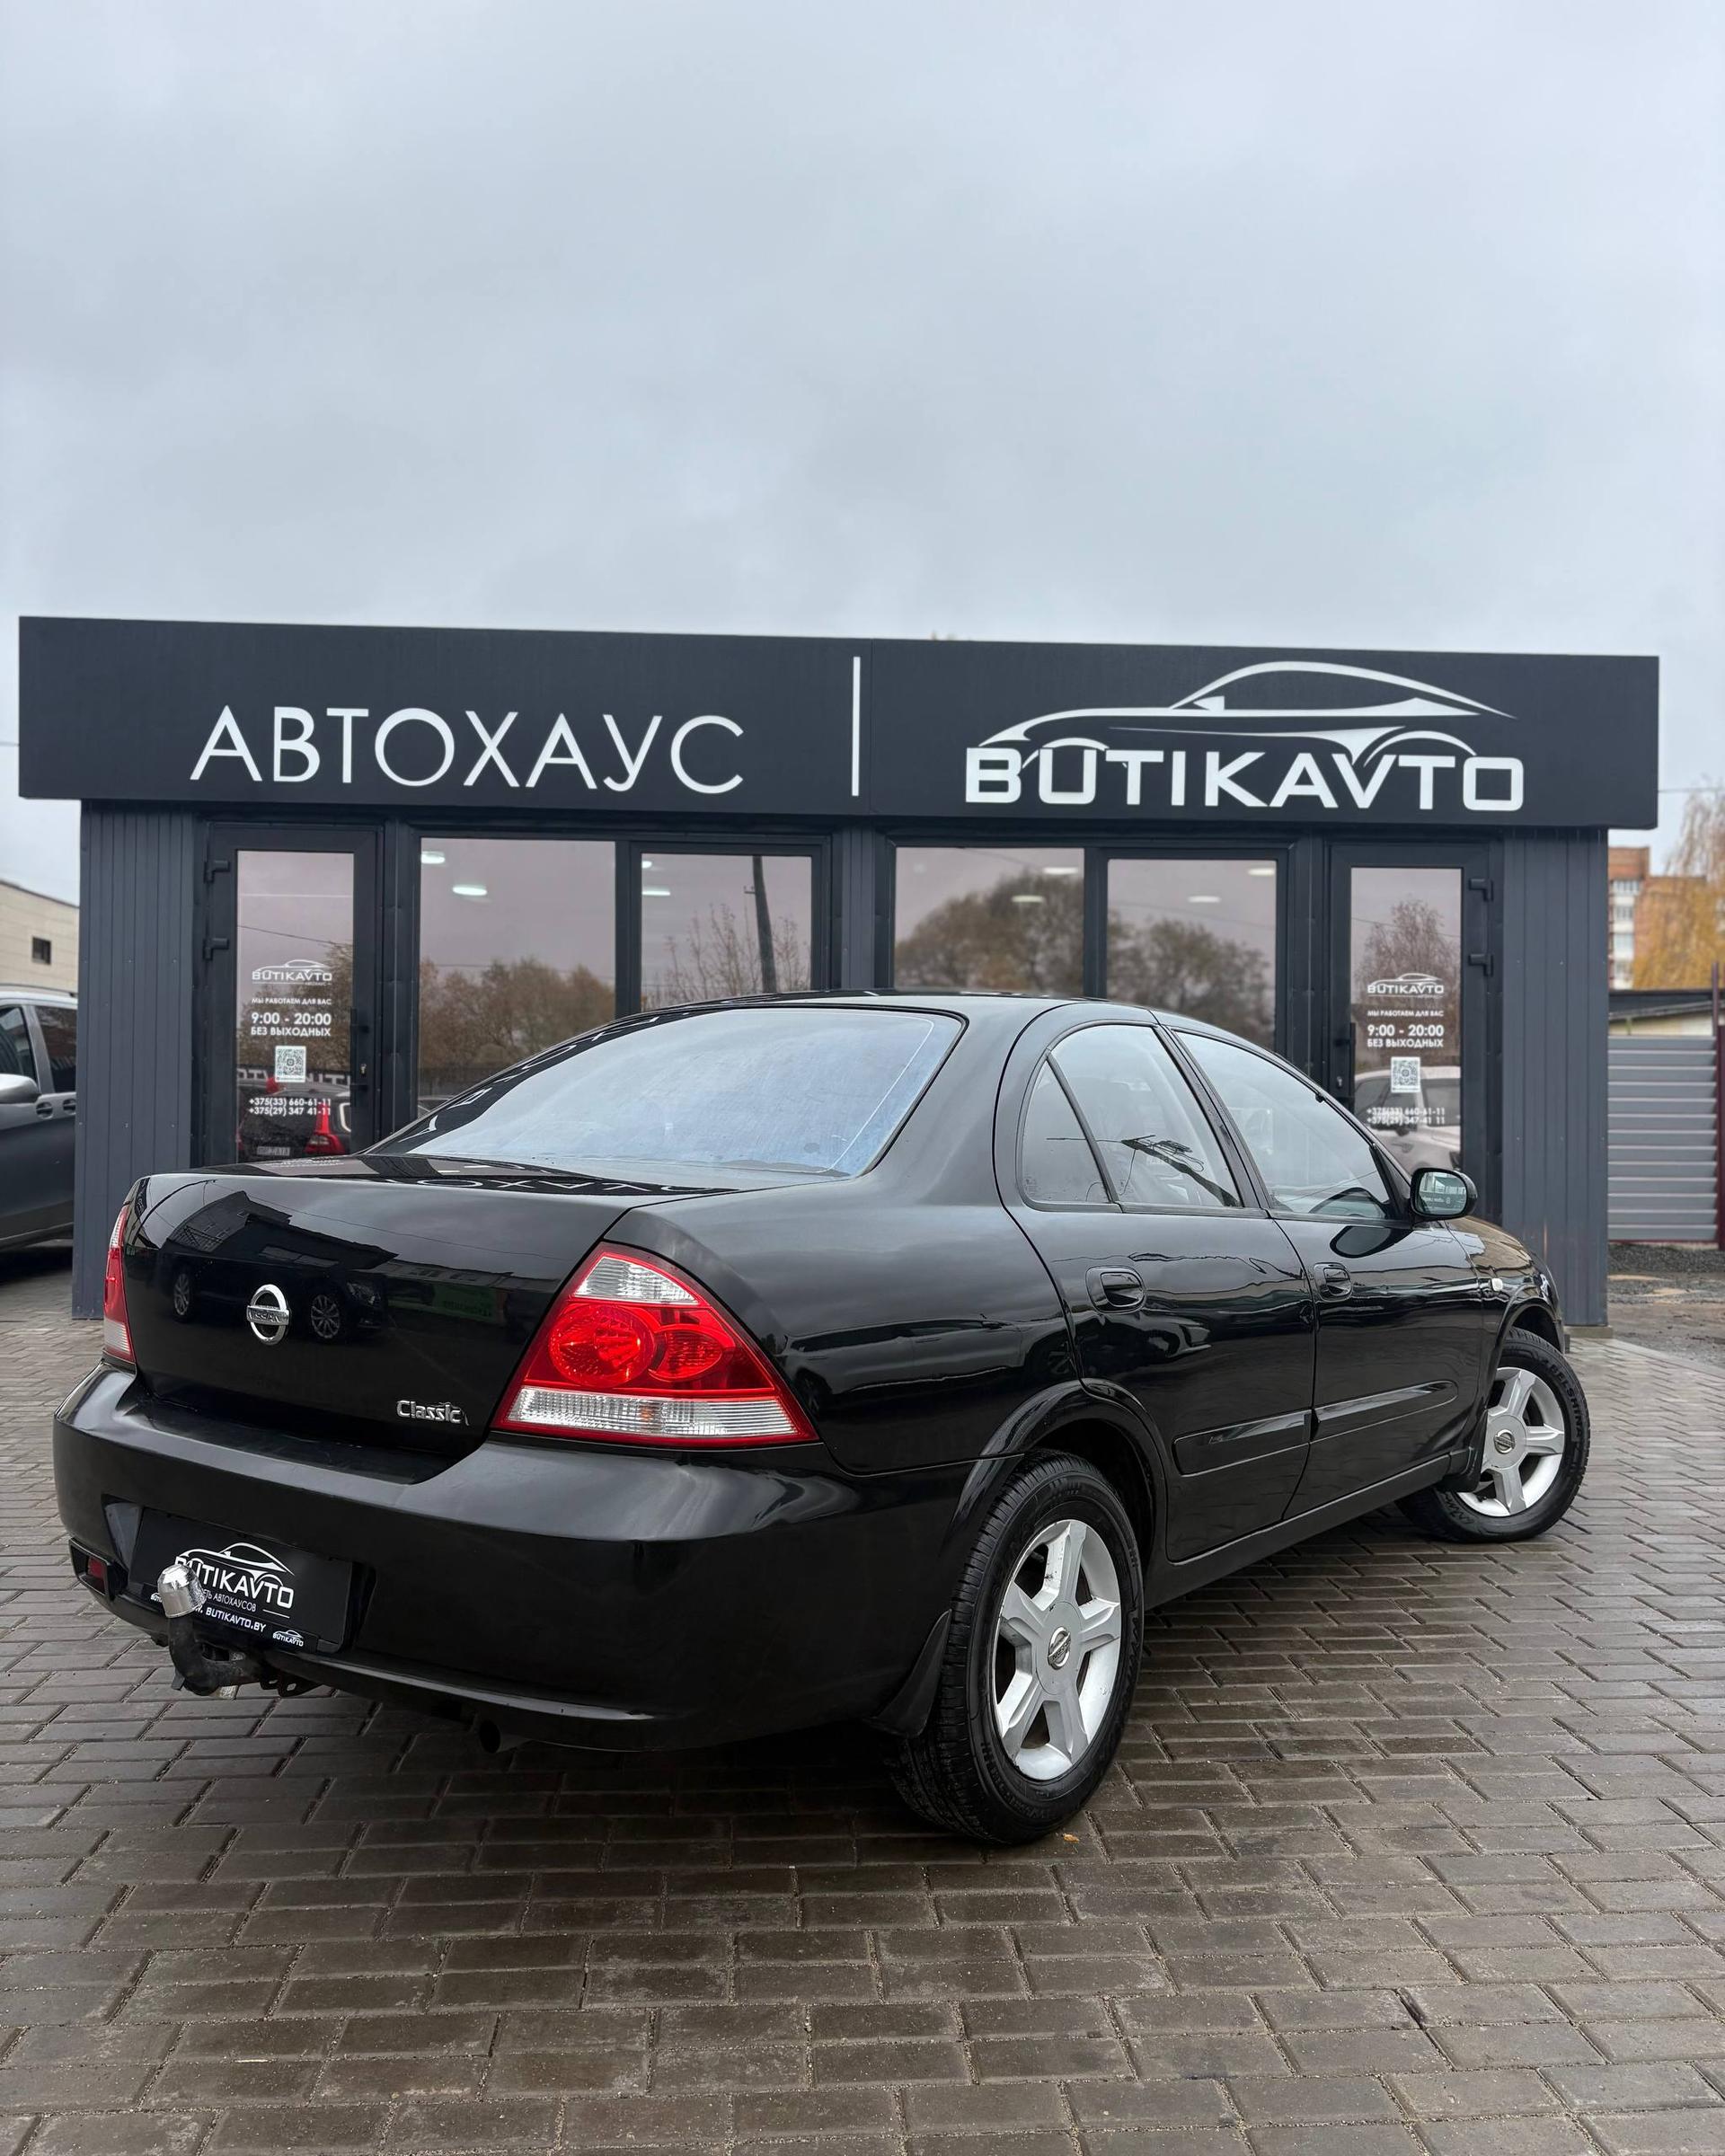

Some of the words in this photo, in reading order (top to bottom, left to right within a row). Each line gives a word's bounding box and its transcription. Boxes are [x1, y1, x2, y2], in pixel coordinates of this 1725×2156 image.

[190, 705, 744, 794] АВТОХАУС
[965, 747, 1525, 811] BUTIKAVTO
[252, 970, 332, 982] BUTIKAVTO
[1367, 984, 1445, 994] BUTIKAVTO
[251, 1012, 280, 1024] 9:00
[293, 1012, 332, 1026] 20:00
[251, 1026, 268, 1036] БЕЗ
[270, 1027, 332, 1038] ВЫХОДНЫХ
[1367, 1023, 1395, 1037] 9:00
[1408, 1024, 1445, 1037] 20:00
[1367, 1038, 1384, 1047] БЕЗ
[1385, 1038, 1444, 1048] ВЫХОДНЫХ
[248, 1097, 288, 1108] +375(33)
[288, 1098, 332, 1107] 660-61-11
[396, 1400, 461, 1424] Classic
[212, 1593, 257, 1613] АВТОХАУСОВ
[206, 1607, 267, 1633] BUTIKAVTO.BY
[272, 1632, 305, 1648] BUTIKAVTO
